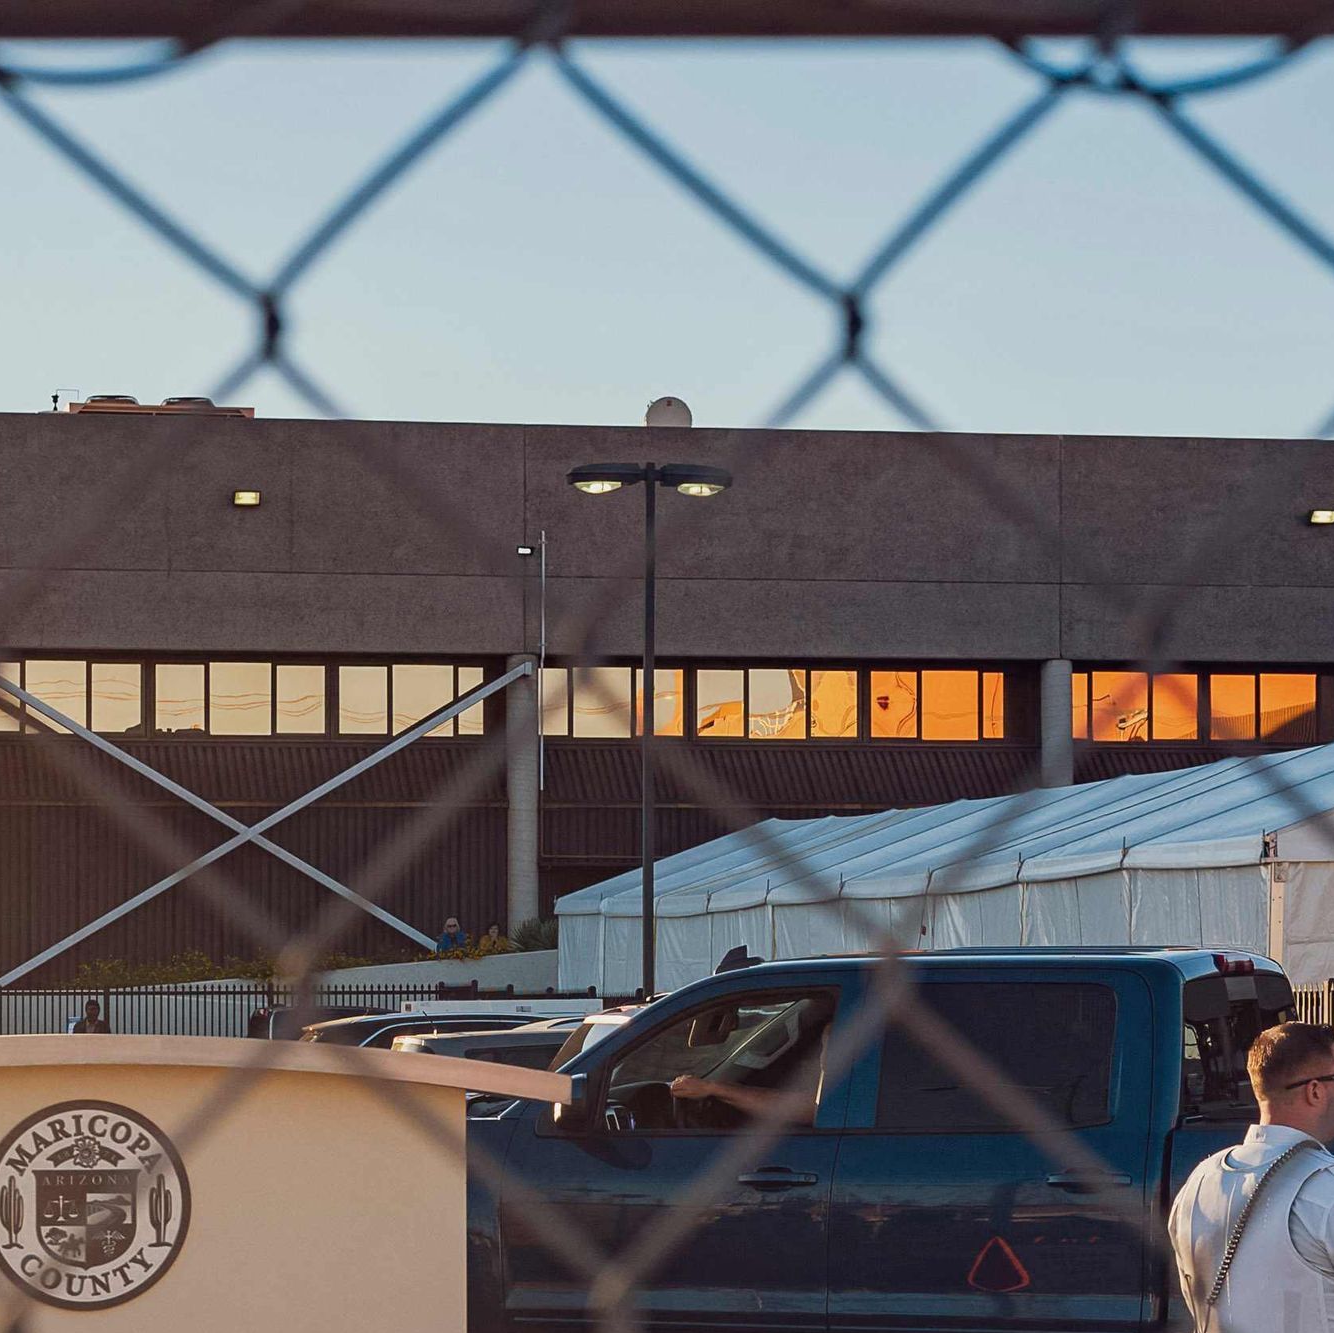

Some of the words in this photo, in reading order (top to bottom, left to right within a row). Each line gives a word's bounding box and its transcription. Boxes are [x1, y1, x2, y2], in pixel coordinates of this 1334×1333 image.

[5, 1115, 163, 1177] MARICOPA
[42, 1175, 132, 1186] ARIZONA
[20, 1247, 154, 1297] COUNTY
